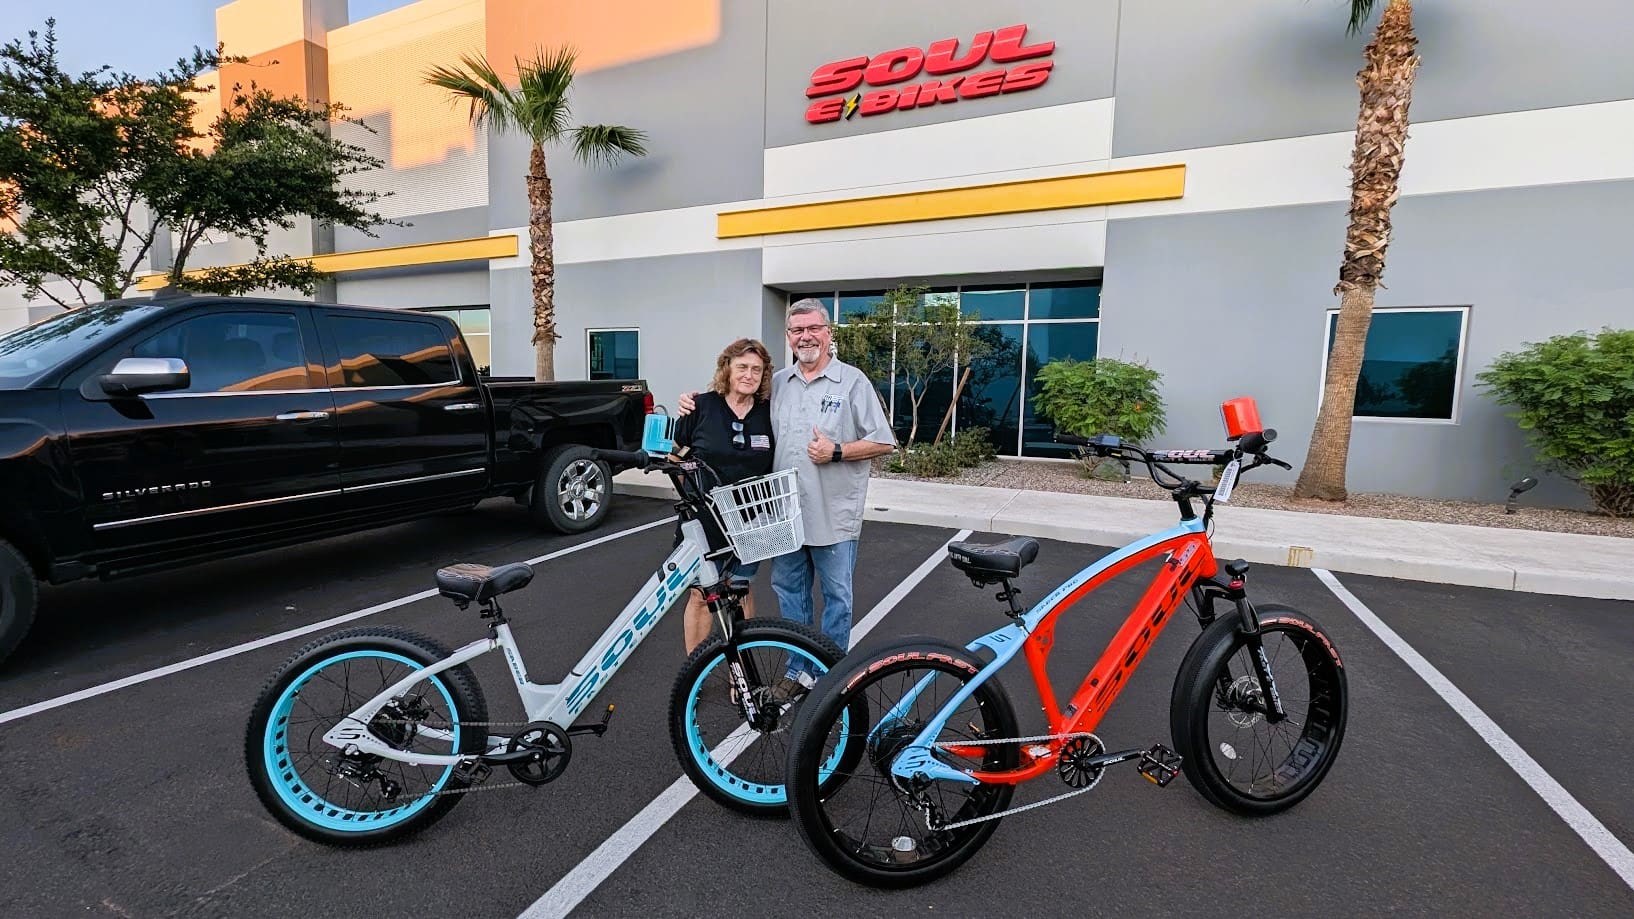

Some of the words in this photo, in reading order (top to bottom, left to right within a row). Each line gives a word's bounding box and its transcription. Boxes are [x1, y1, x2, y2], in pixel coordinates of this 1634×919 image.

[806, 24, 1055, 99] SOUL
[102, 480, 211, 500] SILVERADO
[566, 556, 701, 715] SOUL
[1095, 552, 1206, 713] SOUL
[731, 662, 757, 722] SOUL
